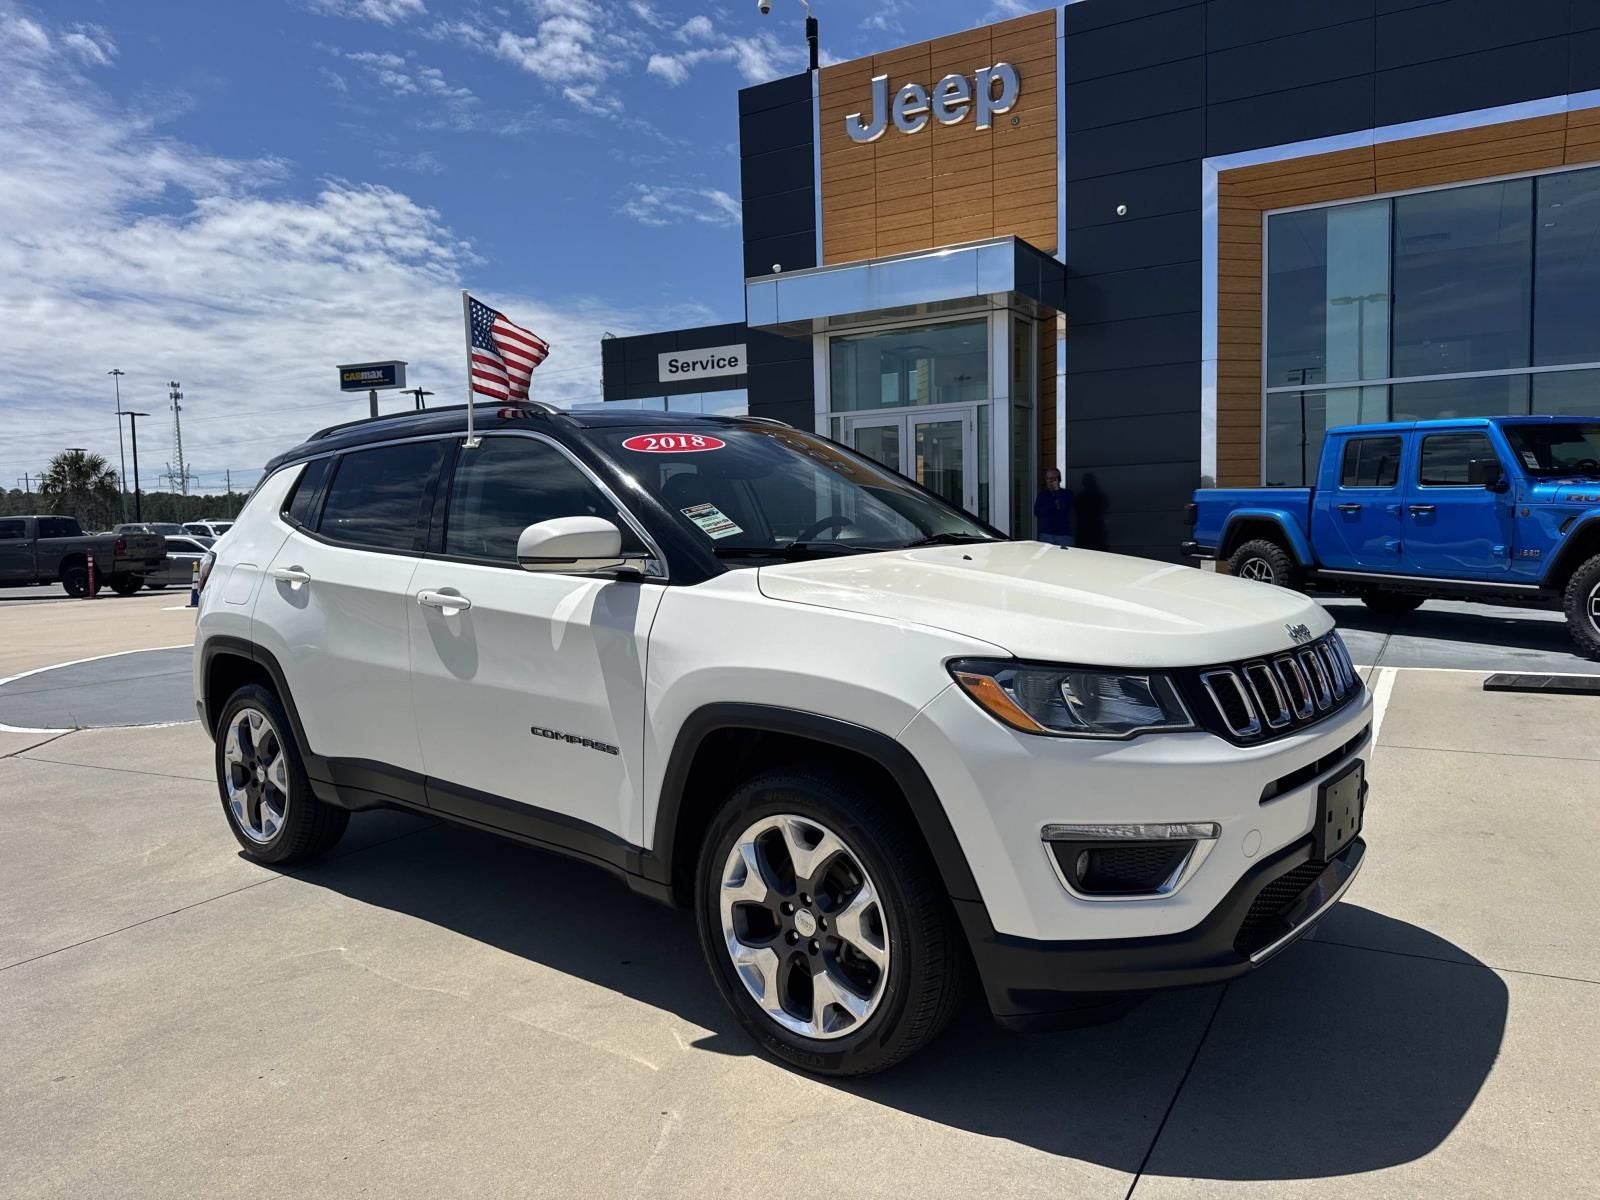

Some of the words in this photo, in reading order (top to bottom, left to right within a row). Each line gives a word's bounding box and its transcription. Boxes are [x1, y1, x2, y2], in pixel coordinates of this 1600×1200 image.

[846, 62, 1020, 143] Jeep
[668, 354, 739, 374] Service
[643, 435, 706, 450] 2018
[530, 726, 619, 755] COMPASS
